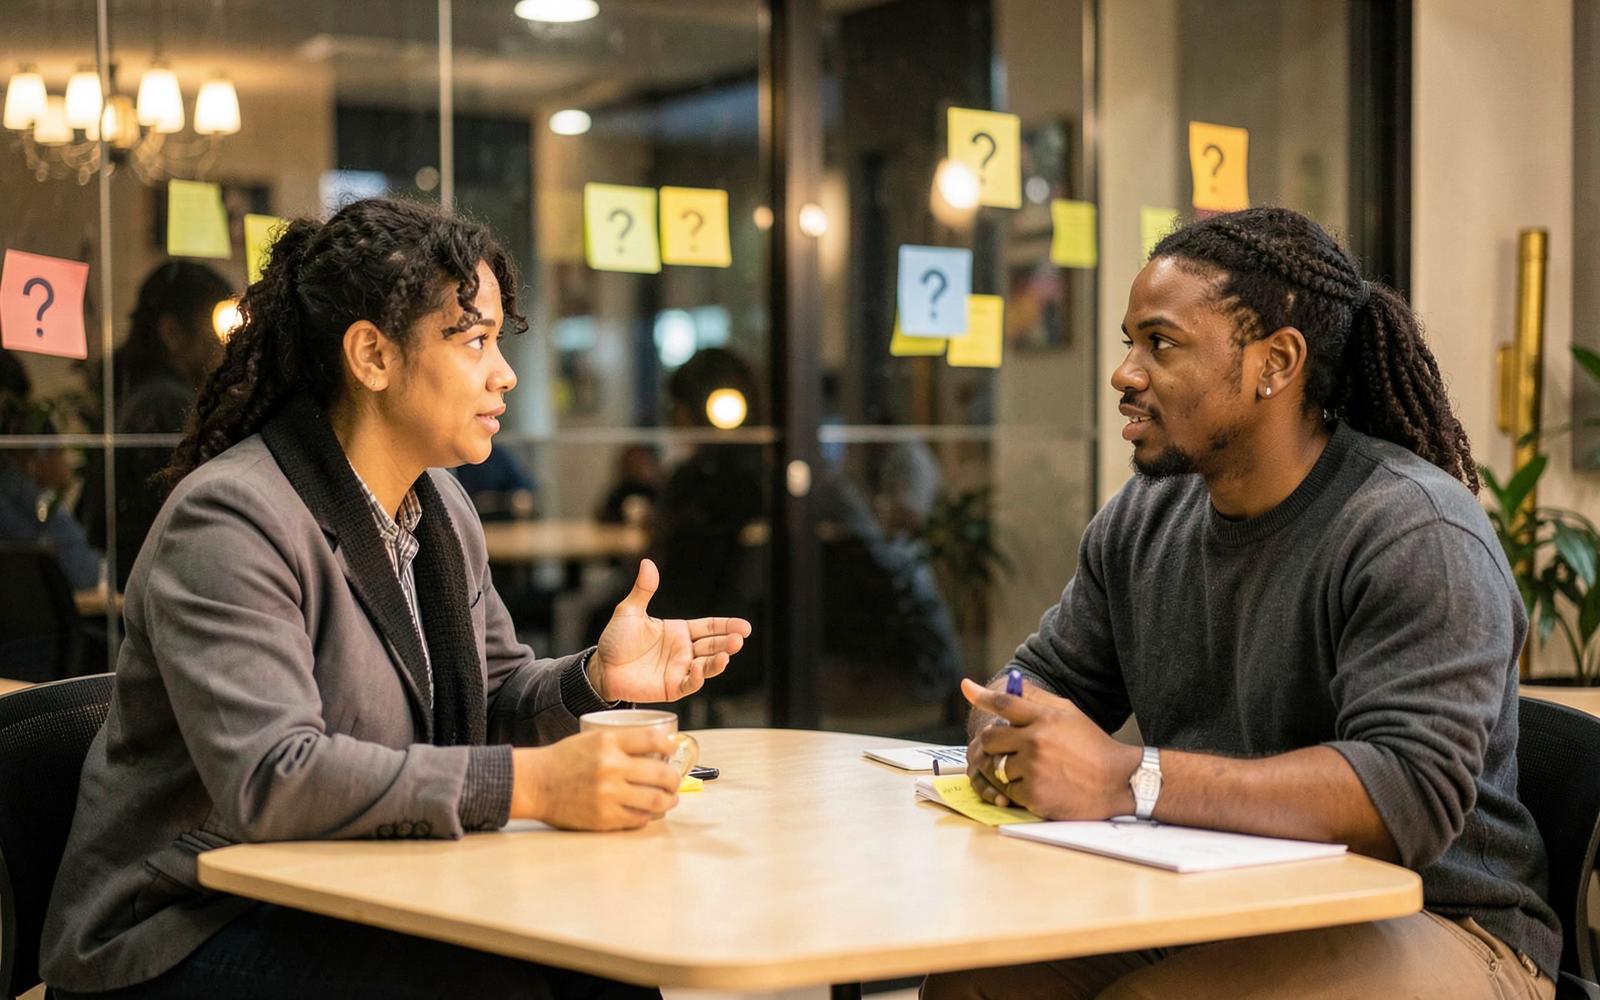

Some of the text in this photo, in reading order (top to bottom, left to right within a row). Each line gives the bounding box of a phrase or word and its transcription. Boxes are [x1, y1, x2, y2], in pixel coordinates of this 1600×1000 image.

[971, 133, 996, 185] ?
[1202, 144, 1225, 193] ?
[608, 208, 634, 254] ?
[681, 209, 704, 252] ?
[22, 277, 54, 337] ?
[920, 269, 948, 319] ?
